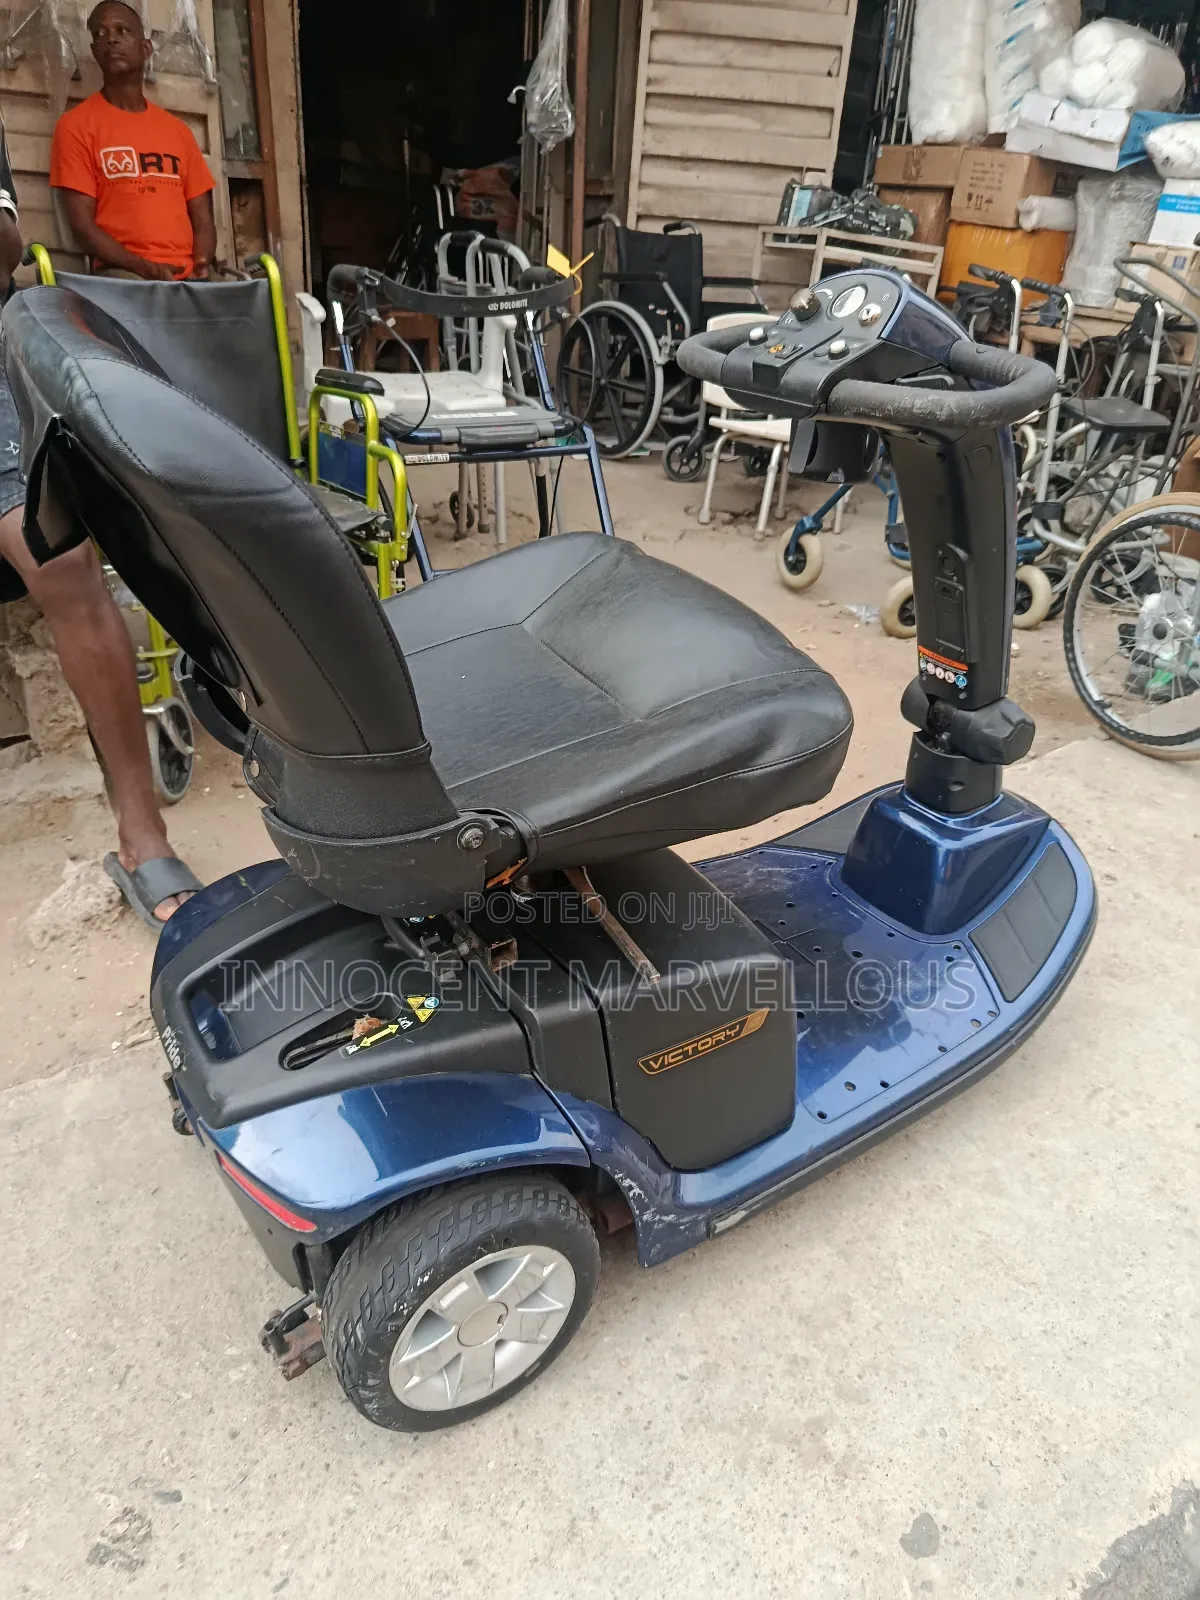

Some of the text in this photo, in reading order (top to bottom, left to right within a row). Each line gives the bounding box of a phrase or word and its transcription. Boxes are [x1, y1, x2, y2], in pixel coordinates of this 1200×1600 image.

[139, 153, 181, 174] RT
[161, 1025, 181, 1069] Pride
[649, 1024, 740, 1069] VICTORY
